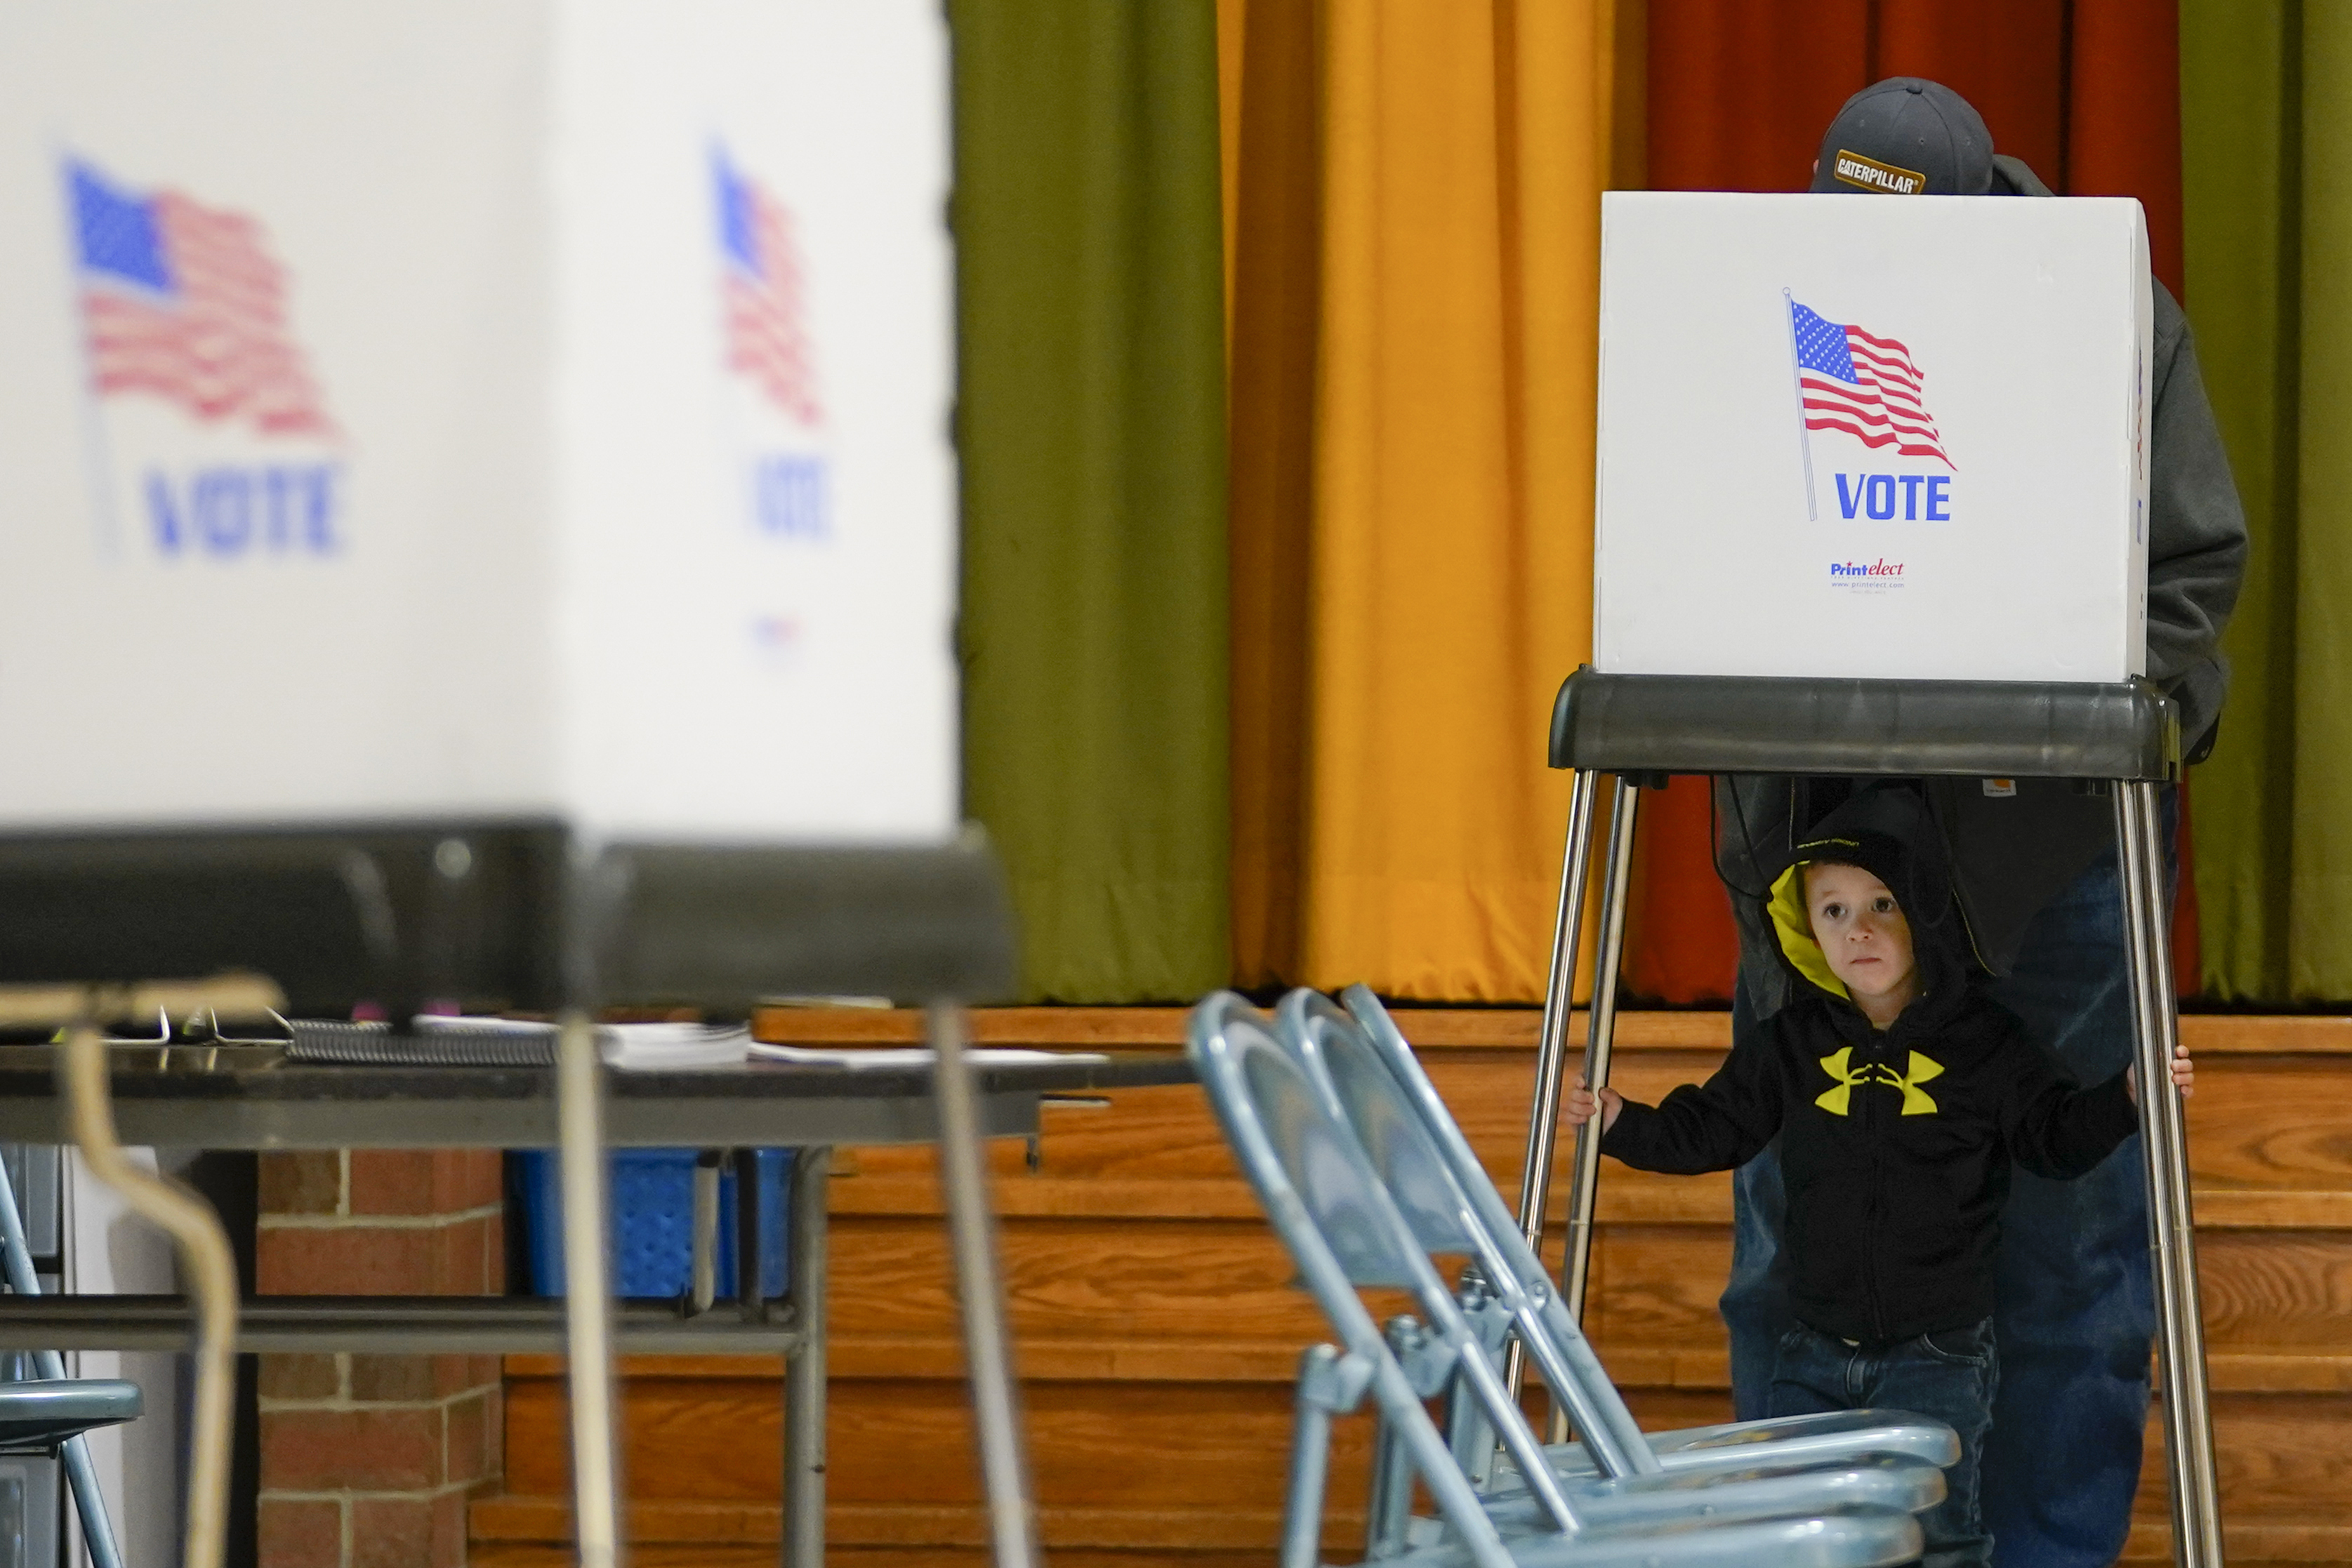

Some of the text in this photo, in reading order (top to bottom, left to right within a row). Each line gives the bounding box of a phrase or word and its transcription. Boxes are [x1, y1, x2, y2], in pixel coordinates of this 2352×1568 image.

[145, 463, 341, 557] VOTE
[1835, 473, 1950, 521] VOTE
[1831, 558, 1904, 576] Printelect
